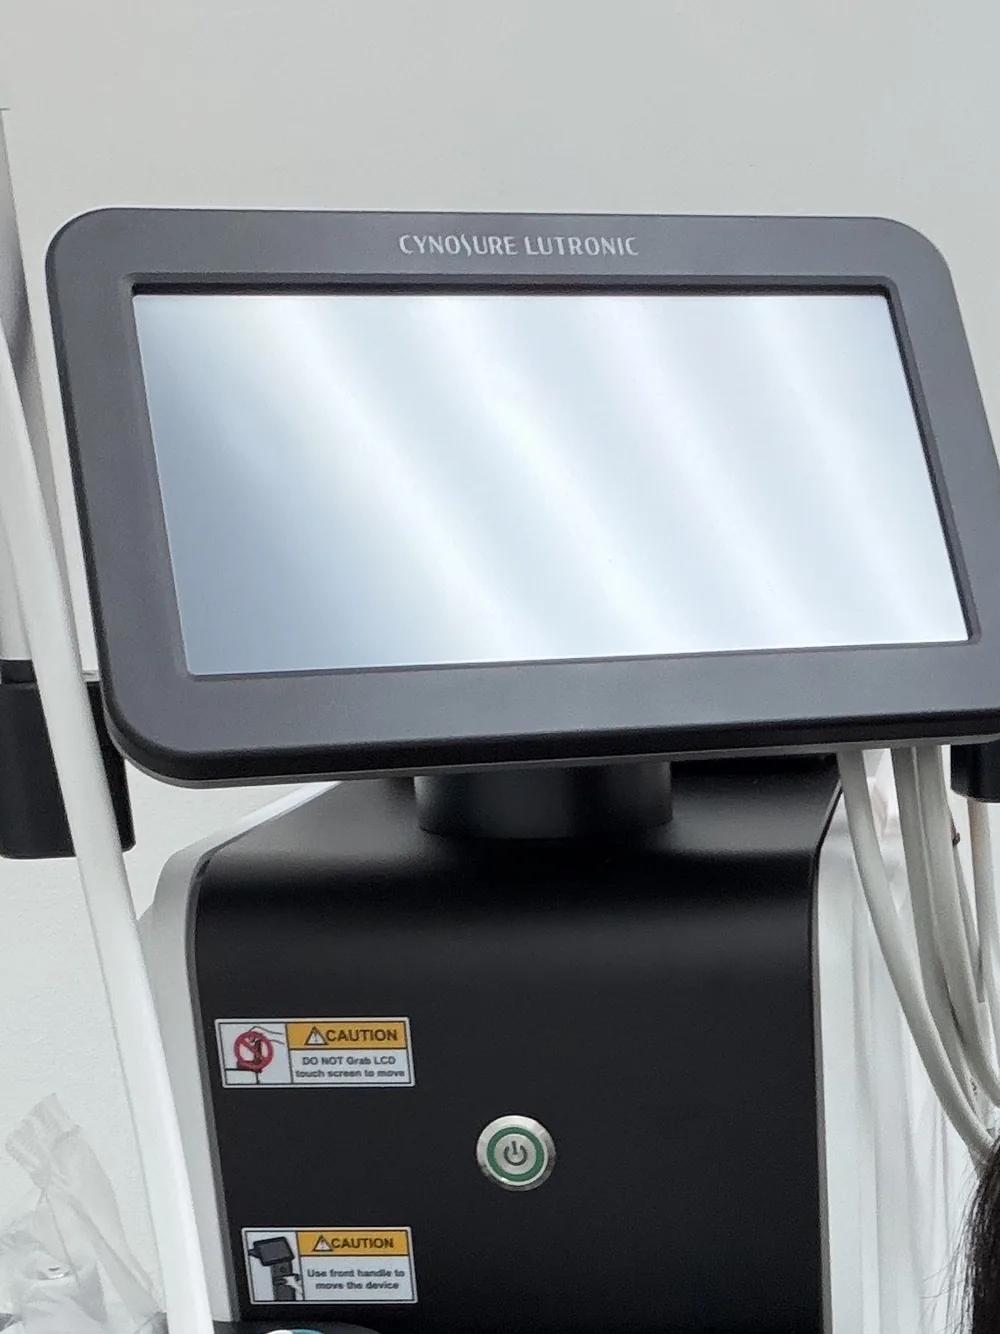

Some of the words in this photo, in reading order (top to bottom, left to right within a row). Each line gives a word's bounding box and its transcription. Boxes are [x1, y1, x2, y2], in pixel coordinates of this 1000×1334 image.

[400, 234, 517, 257] CYNOSURE
[524, 236, 639, 256] LUTRONIC
[325, 1029, 397, 1041] CAUTION
[302, 1056, 319, 1065] DO
[322, 1056, 344, 1065] NOT
[346, 1056, 371, 1065] Grab
[374, 1055, 396, 1065] LCD
[295, 1069, 325, 1078] touch
[364, 1069, 375, 1077] to
[331, 1237, 394, 1248] CAUTION
[307, 1268, 327, 1277] Use
[329, 1268, 355, 1277] front
[357, 1268, 392, 1277] handle
[394, 1269, 405, 1277] to
[315, 1282, 344, 1290] move
[346, 1281, 363, 1290] the
[365, 1281, 400, 1289] device
